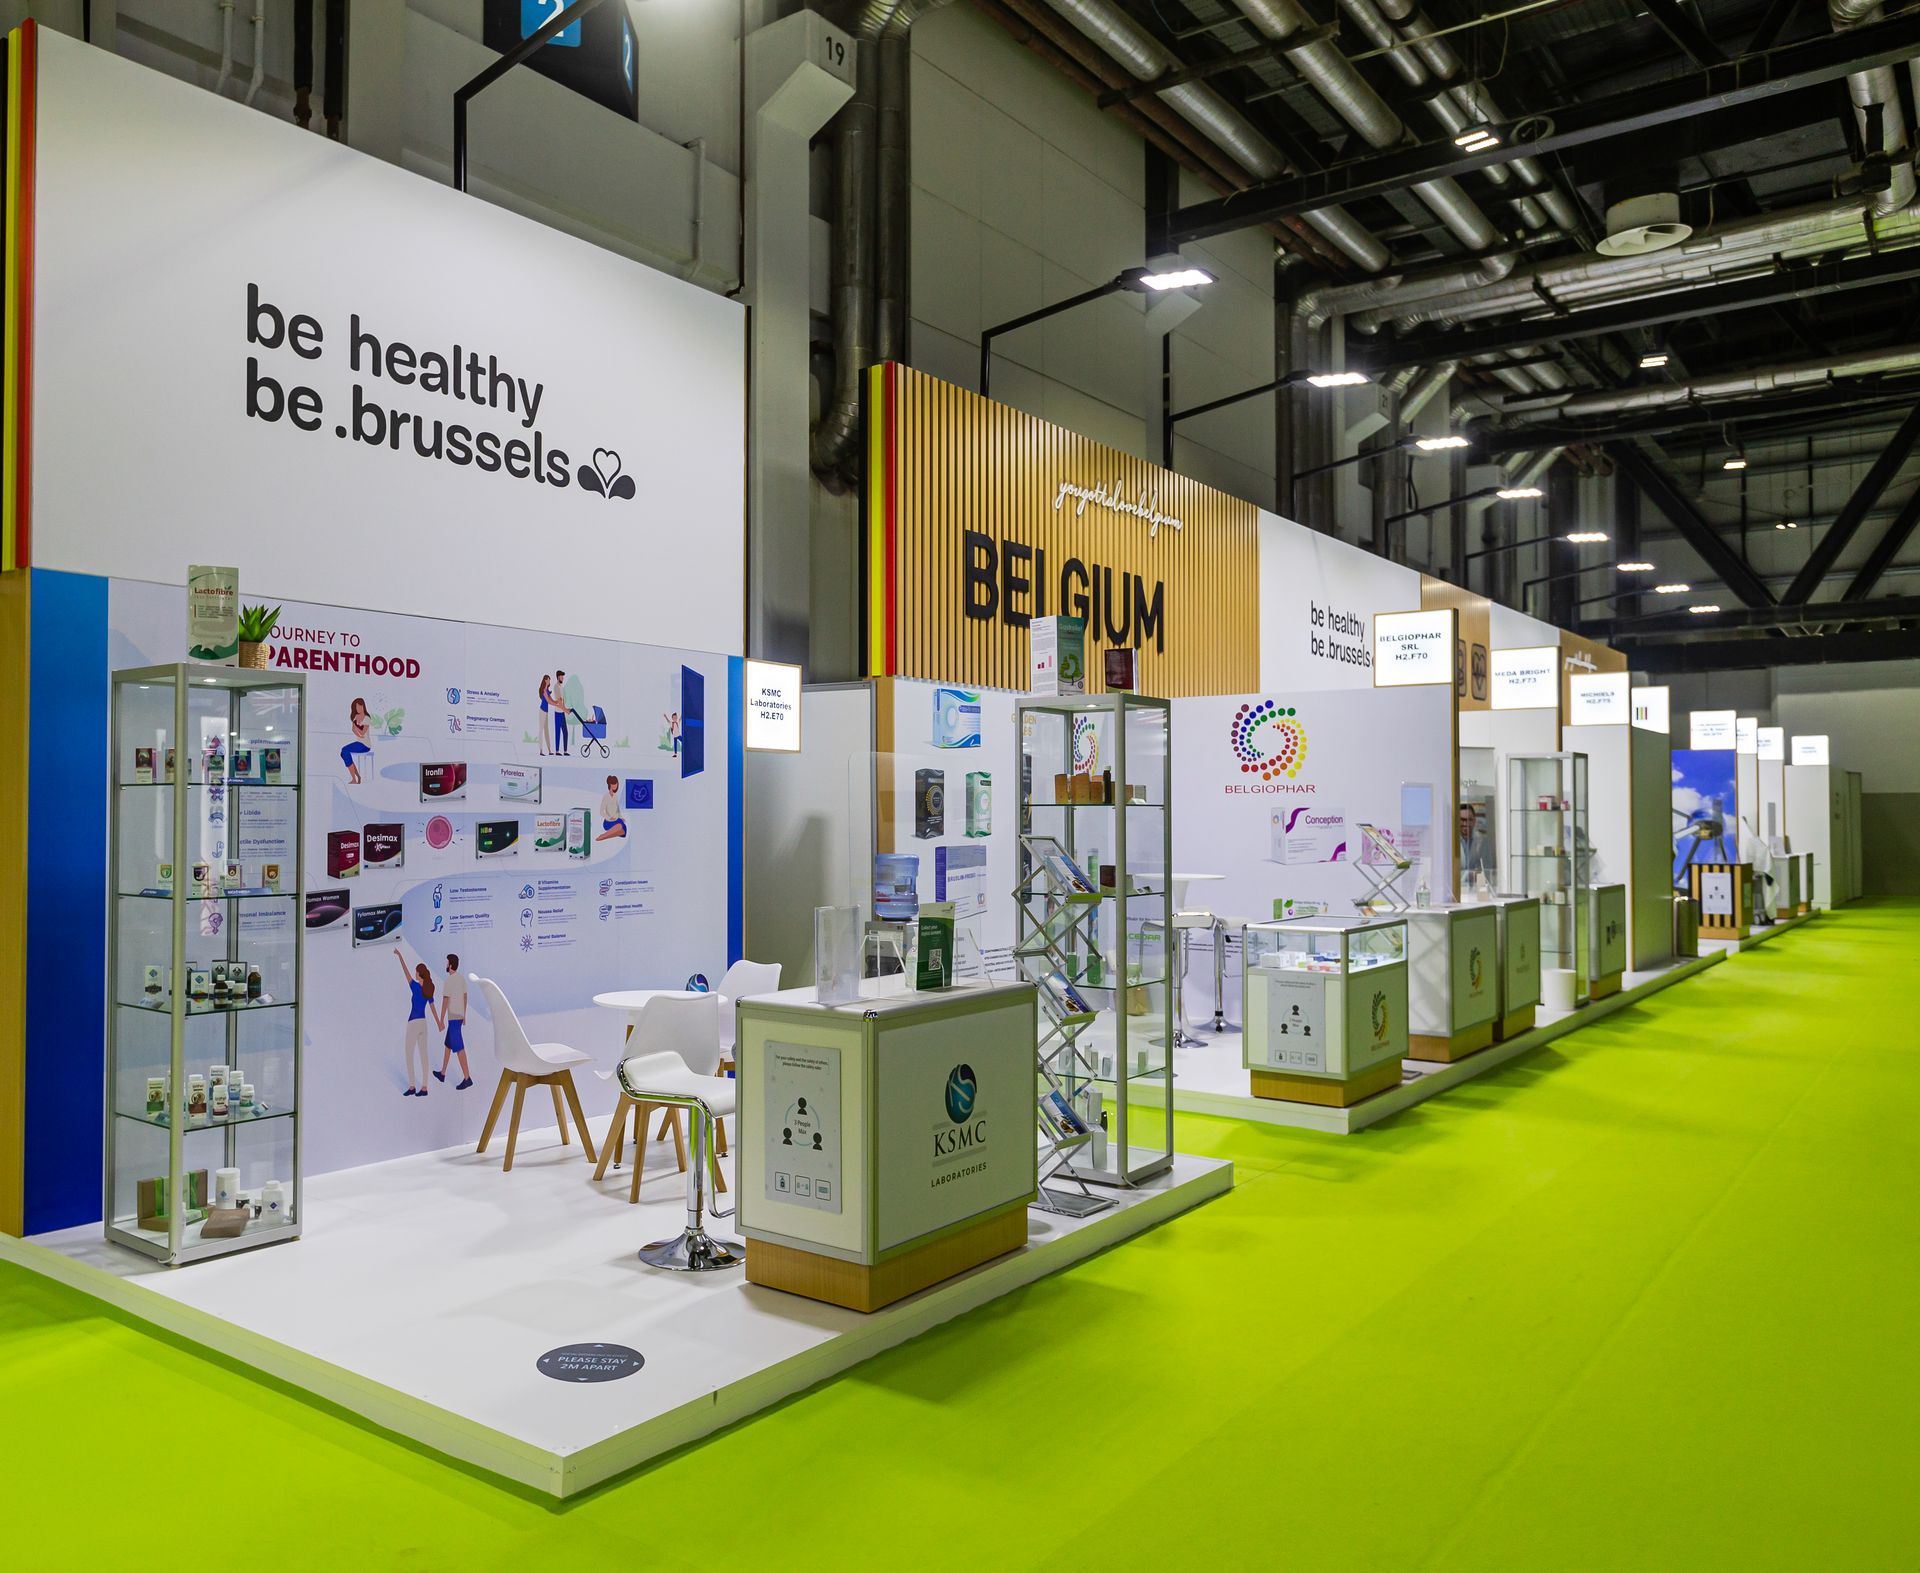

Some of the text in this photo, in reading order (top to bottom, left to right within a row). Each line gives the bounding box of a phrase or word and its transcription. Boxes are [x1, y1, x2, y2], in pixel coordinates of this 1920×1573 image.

[825, 36, 846, 67] 19
[247, 282, 544, 429] be healthy
[246, 357, 324, 432] be
[194, 586, 234, 596] Lactofibre
[964, 529, 1164, 655] BELGIUM
[1311, 600, 1365, 643] be healthy
[269, 625, 361, 648] OURNEY TO
[1379, 632, 1442, 642] BELGIOPHAR
[1311, 630, 1325, 657] be
[1401, 643, 1420, 651] SRL
[268, 645, 421, 679] PARENTHOOD
[761, 687, 782, 698] KSMC
[750, 698, 792, 711] Laboratories
[760, 711, 784, 721] H2.E70
[1224, 784, 1316, 794] BELGIOPHAR
[1305, 815, 1344, 826] Conception
[367, 834, 398, 843] Desimax
[797, 1120, 811, 1128] People
[933, 1120, 986, 1158] KSMC
[930, 1161, 987, 1189] LABORATORIES
[558, 1356, 628, 1365] PLEASE STAY
